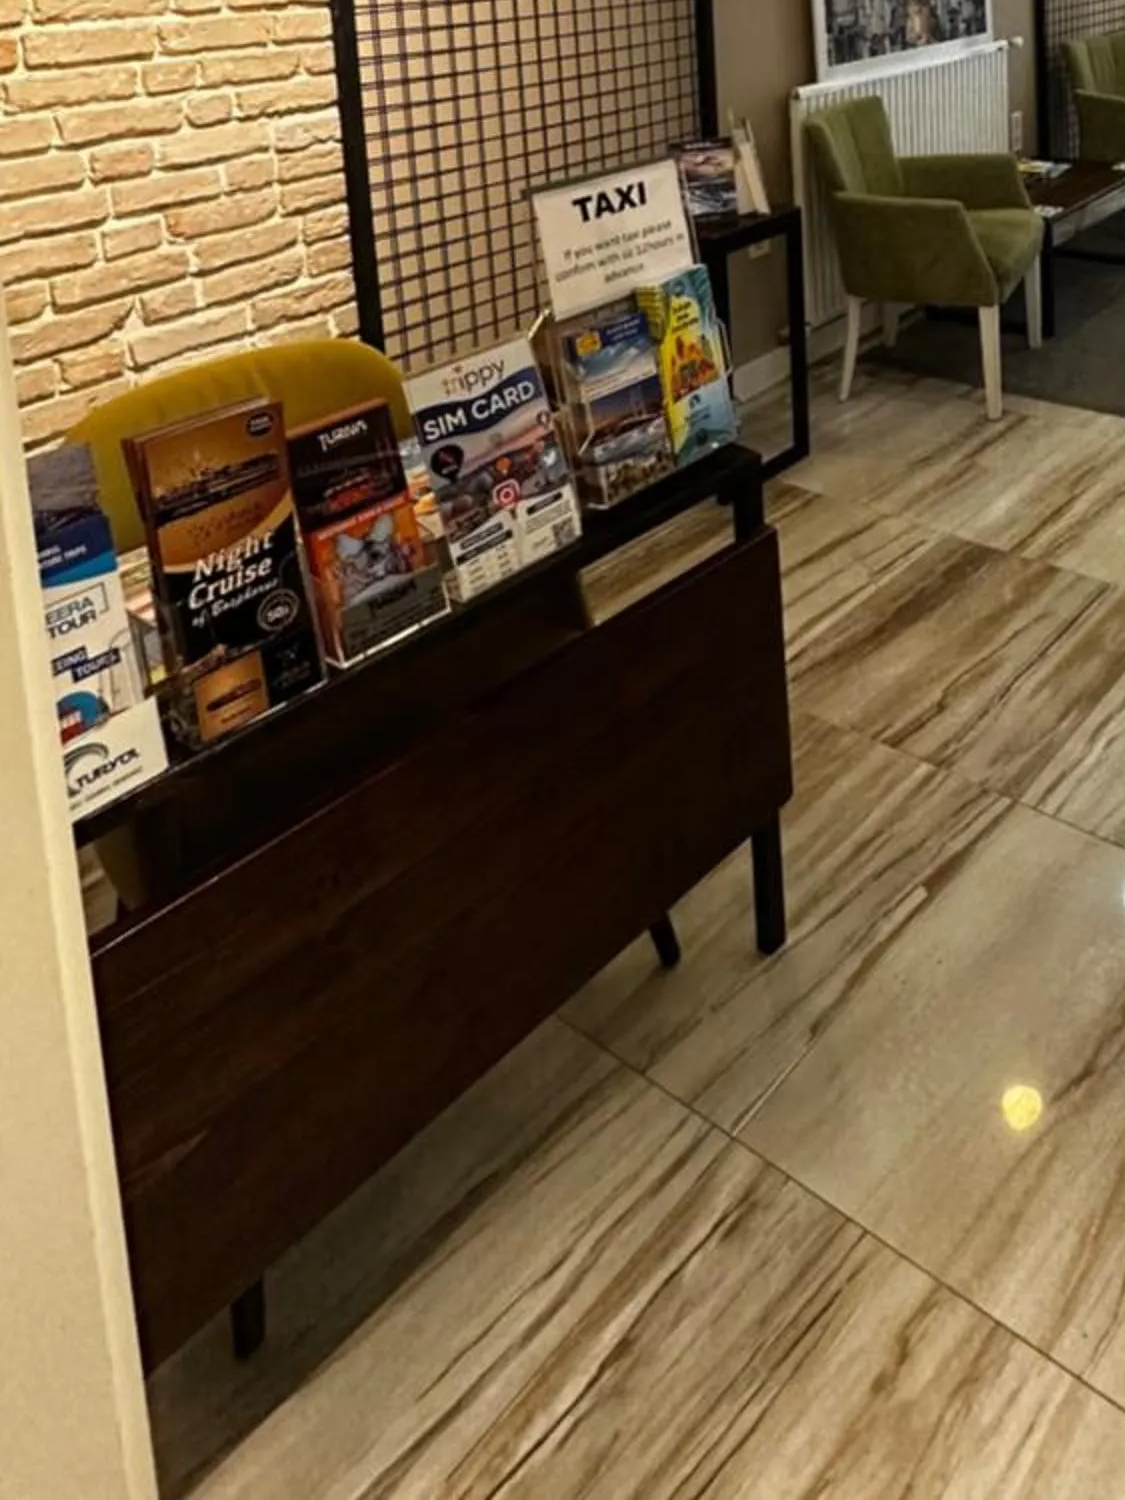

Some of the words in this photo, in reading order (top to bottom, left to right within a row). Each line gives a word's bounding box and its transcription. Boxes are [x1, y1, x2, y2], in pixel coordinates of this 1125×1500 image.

[572, 182, 647, 222] TAXI
[424, 408, 467, 441] SIM
[471, 380, 535, 420] CARD
[193, 531, 273, 582] Night
[188, 557, 272, 610] Cruise
